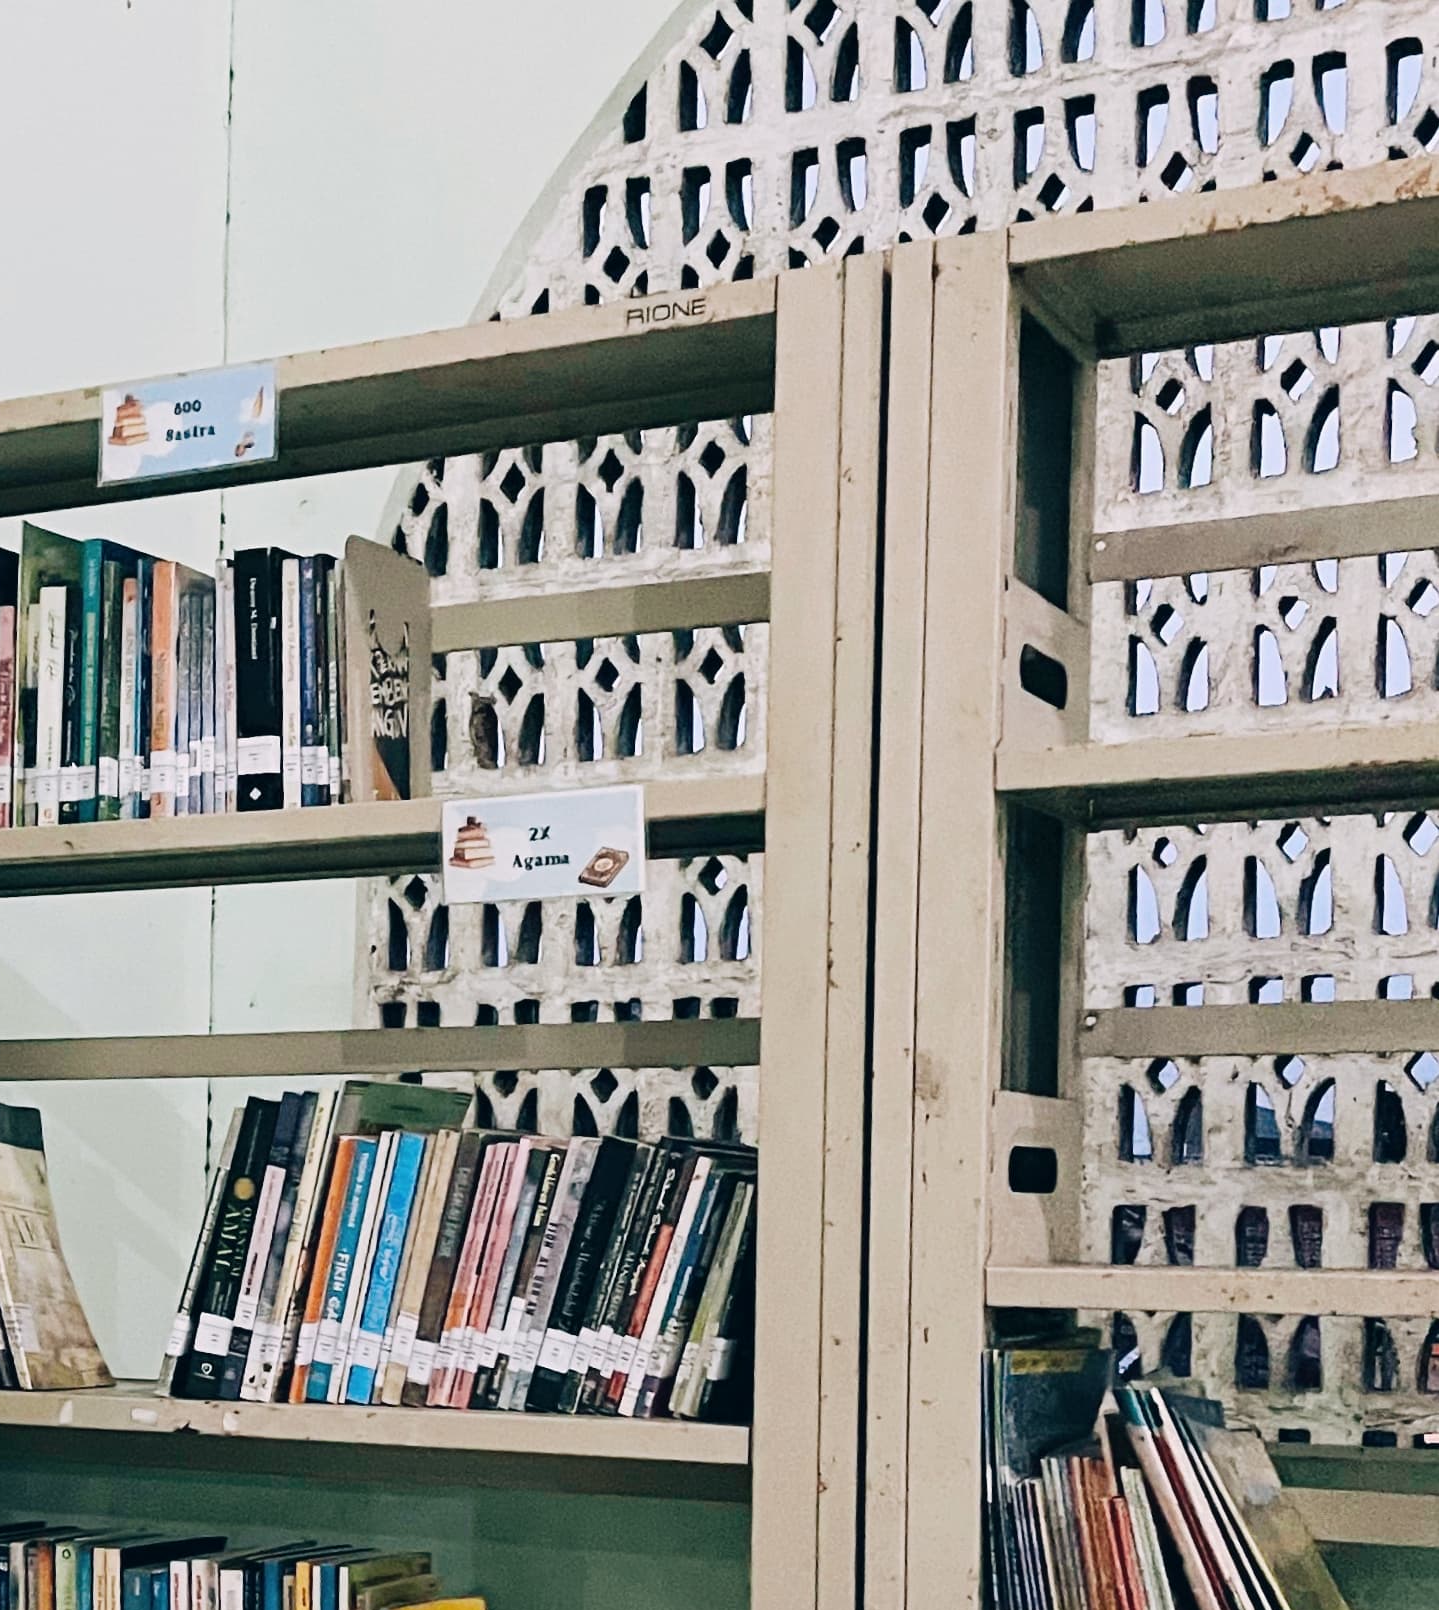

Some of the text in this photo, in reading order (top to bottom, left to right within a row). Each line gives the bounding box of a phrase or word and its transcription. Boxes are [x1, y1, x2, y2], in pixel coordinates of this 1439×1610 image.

[626, 297, 707, 327] RIONE
[174, 399, 202, 416] 800
[165, 425, 216, 442] Sastra
[528, 825, 551, 842] 2X
[512, 853, 570, 871] Agama
